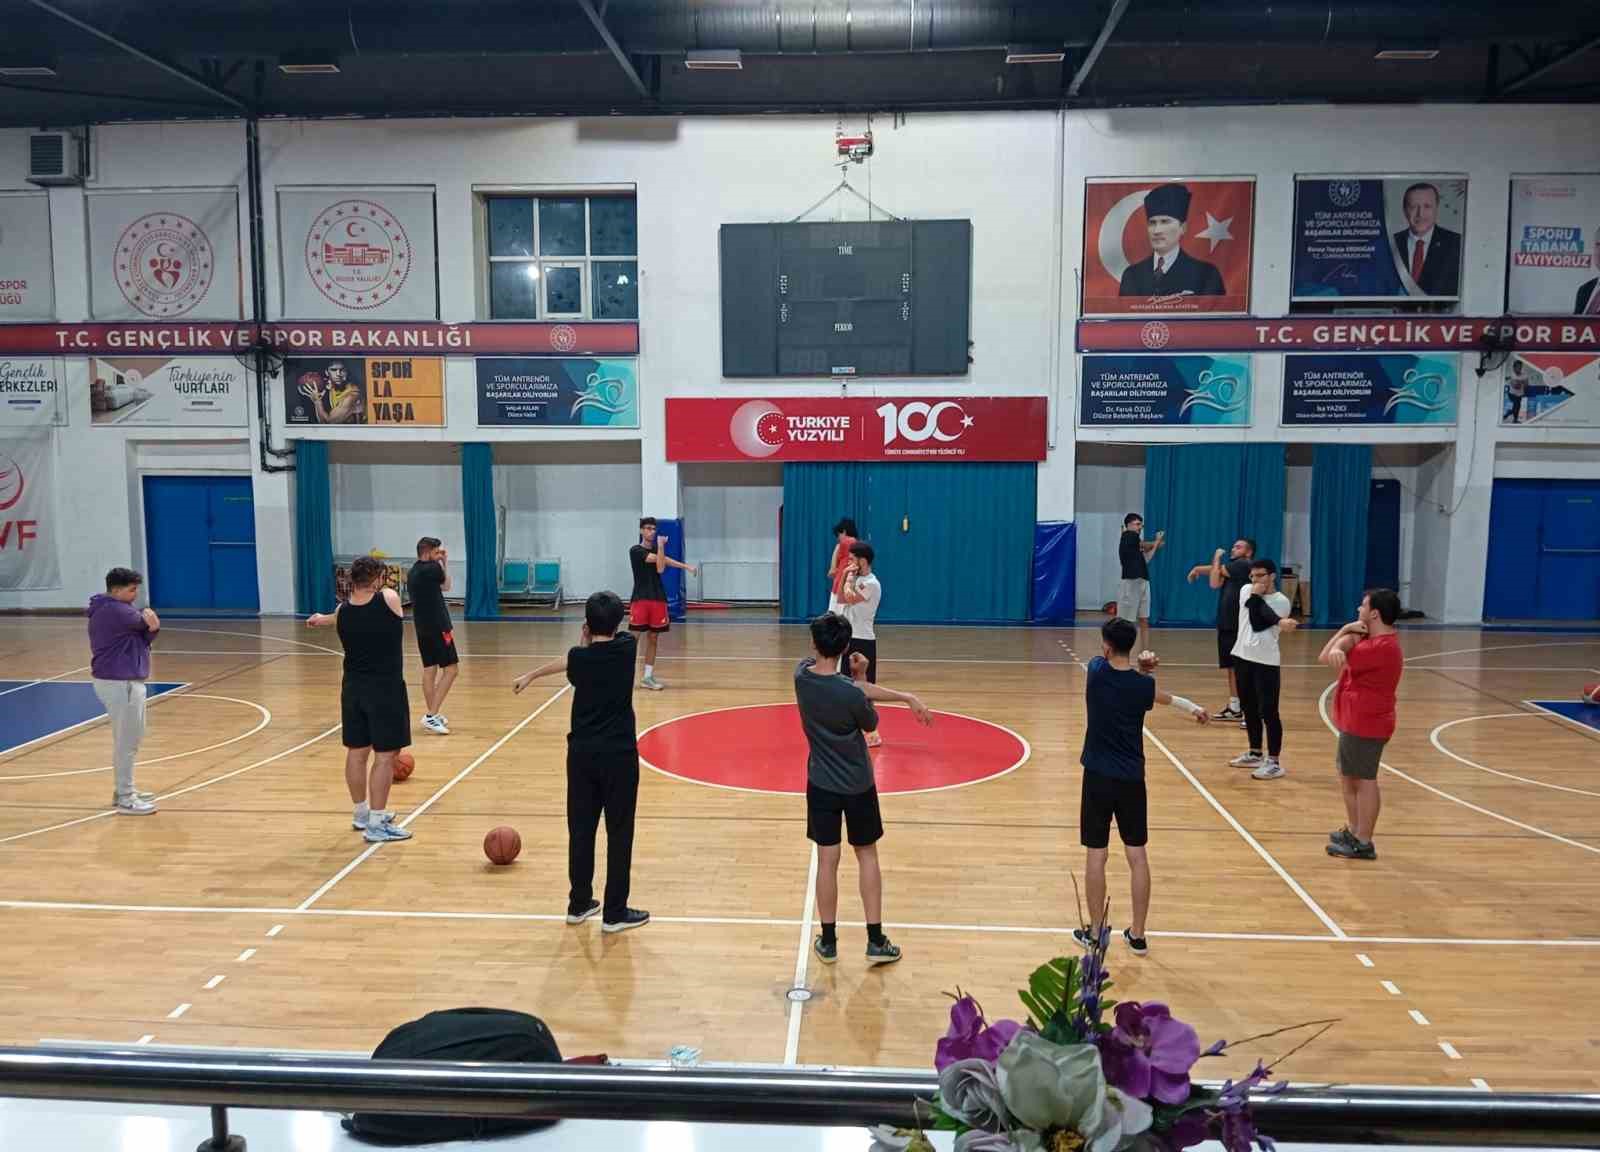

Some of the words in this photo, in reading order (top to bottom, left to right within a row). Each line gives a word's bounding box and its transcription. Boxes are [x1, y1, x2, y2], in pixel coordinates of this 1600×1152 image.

[1528, 227, 1575, 240] SPORU
[1525, 241, 1578, 252] TABANA
[1517, 253, 1590, 266] YAYIYORUZ
[0, 280, 27, 290] SPOR
[55, 330, 97, 347] T.C.
[106, 326, 212, 350] GENÇLİK
[220, 330, 250, 347] VE
[260, 329, 323, 347] SPOR
[332, 326, 471, 347] BAKANLIĞI
[1255, 326, 1302, 343] T.C.
[1313, 321, 1431, 345] GENÇLİK
[1440, 325, 1473, 342] VE
[494, 374, 510, 382] TÜM
[512, 374, 550, 382] ANTRENÖR
[1100, 372, 1117, 380] TÜM
[1119, 372, 1160, 380] ANTRENÖR
[1303, 371, 1320, 380] TÜM
[1322, 371, 1364, 379] ANTRENÖR
[373, 380, 393, 398] LA
[1090, 381, 1100, 389] VE
[1102, 381, 1168, 389] SPORCULARIMIZA
[486, 391, 521, 399] BAŞARILAR
[1091, 390, 1128, 398] BAŞARILAR
[1129, 389, 1167, 397] DİLİYORUM
[1293, 389, 1331, 397] BAŞARILAR
[372, 402, 415, 423] YAŞA
